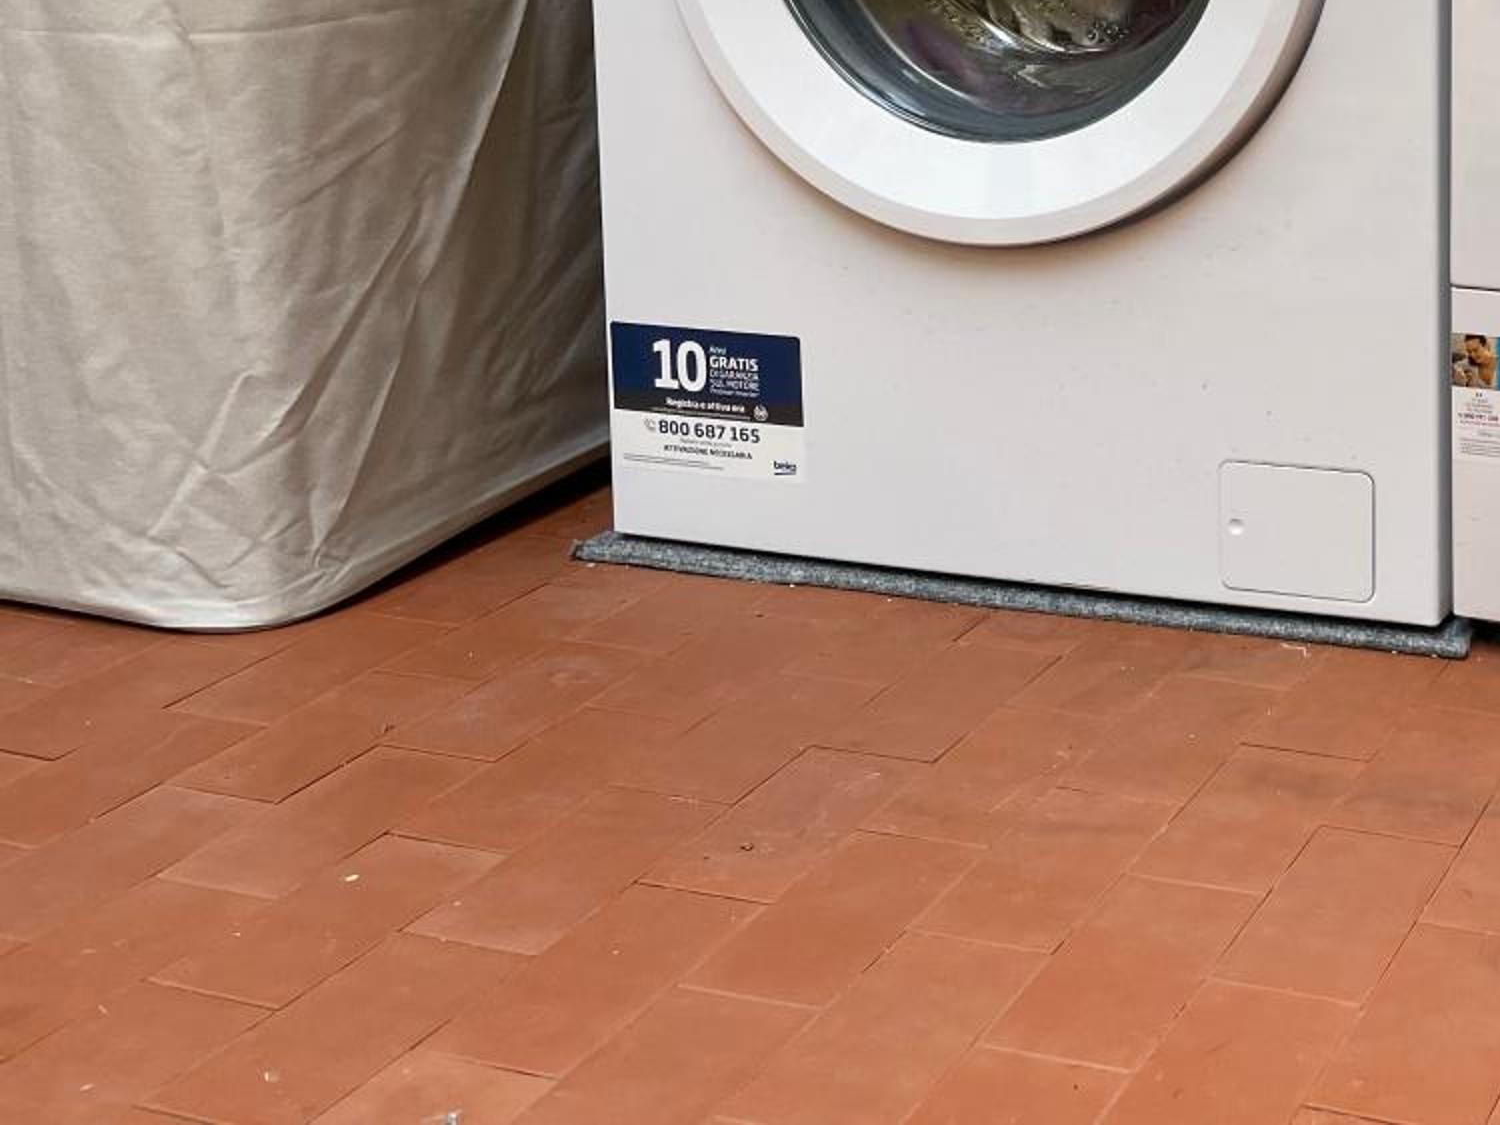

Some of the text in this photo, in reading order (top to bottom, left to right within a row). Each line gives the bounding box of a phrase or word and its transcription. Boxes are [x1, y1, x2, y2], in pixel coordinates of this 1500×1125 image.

[653, 339, 707, 392] 10
[710, 356, 759, 372] GRATIS
[659, 419, 690, 436] 800
[694, 422, 726, 440] 687
[730, 426, 761, 443] 165
